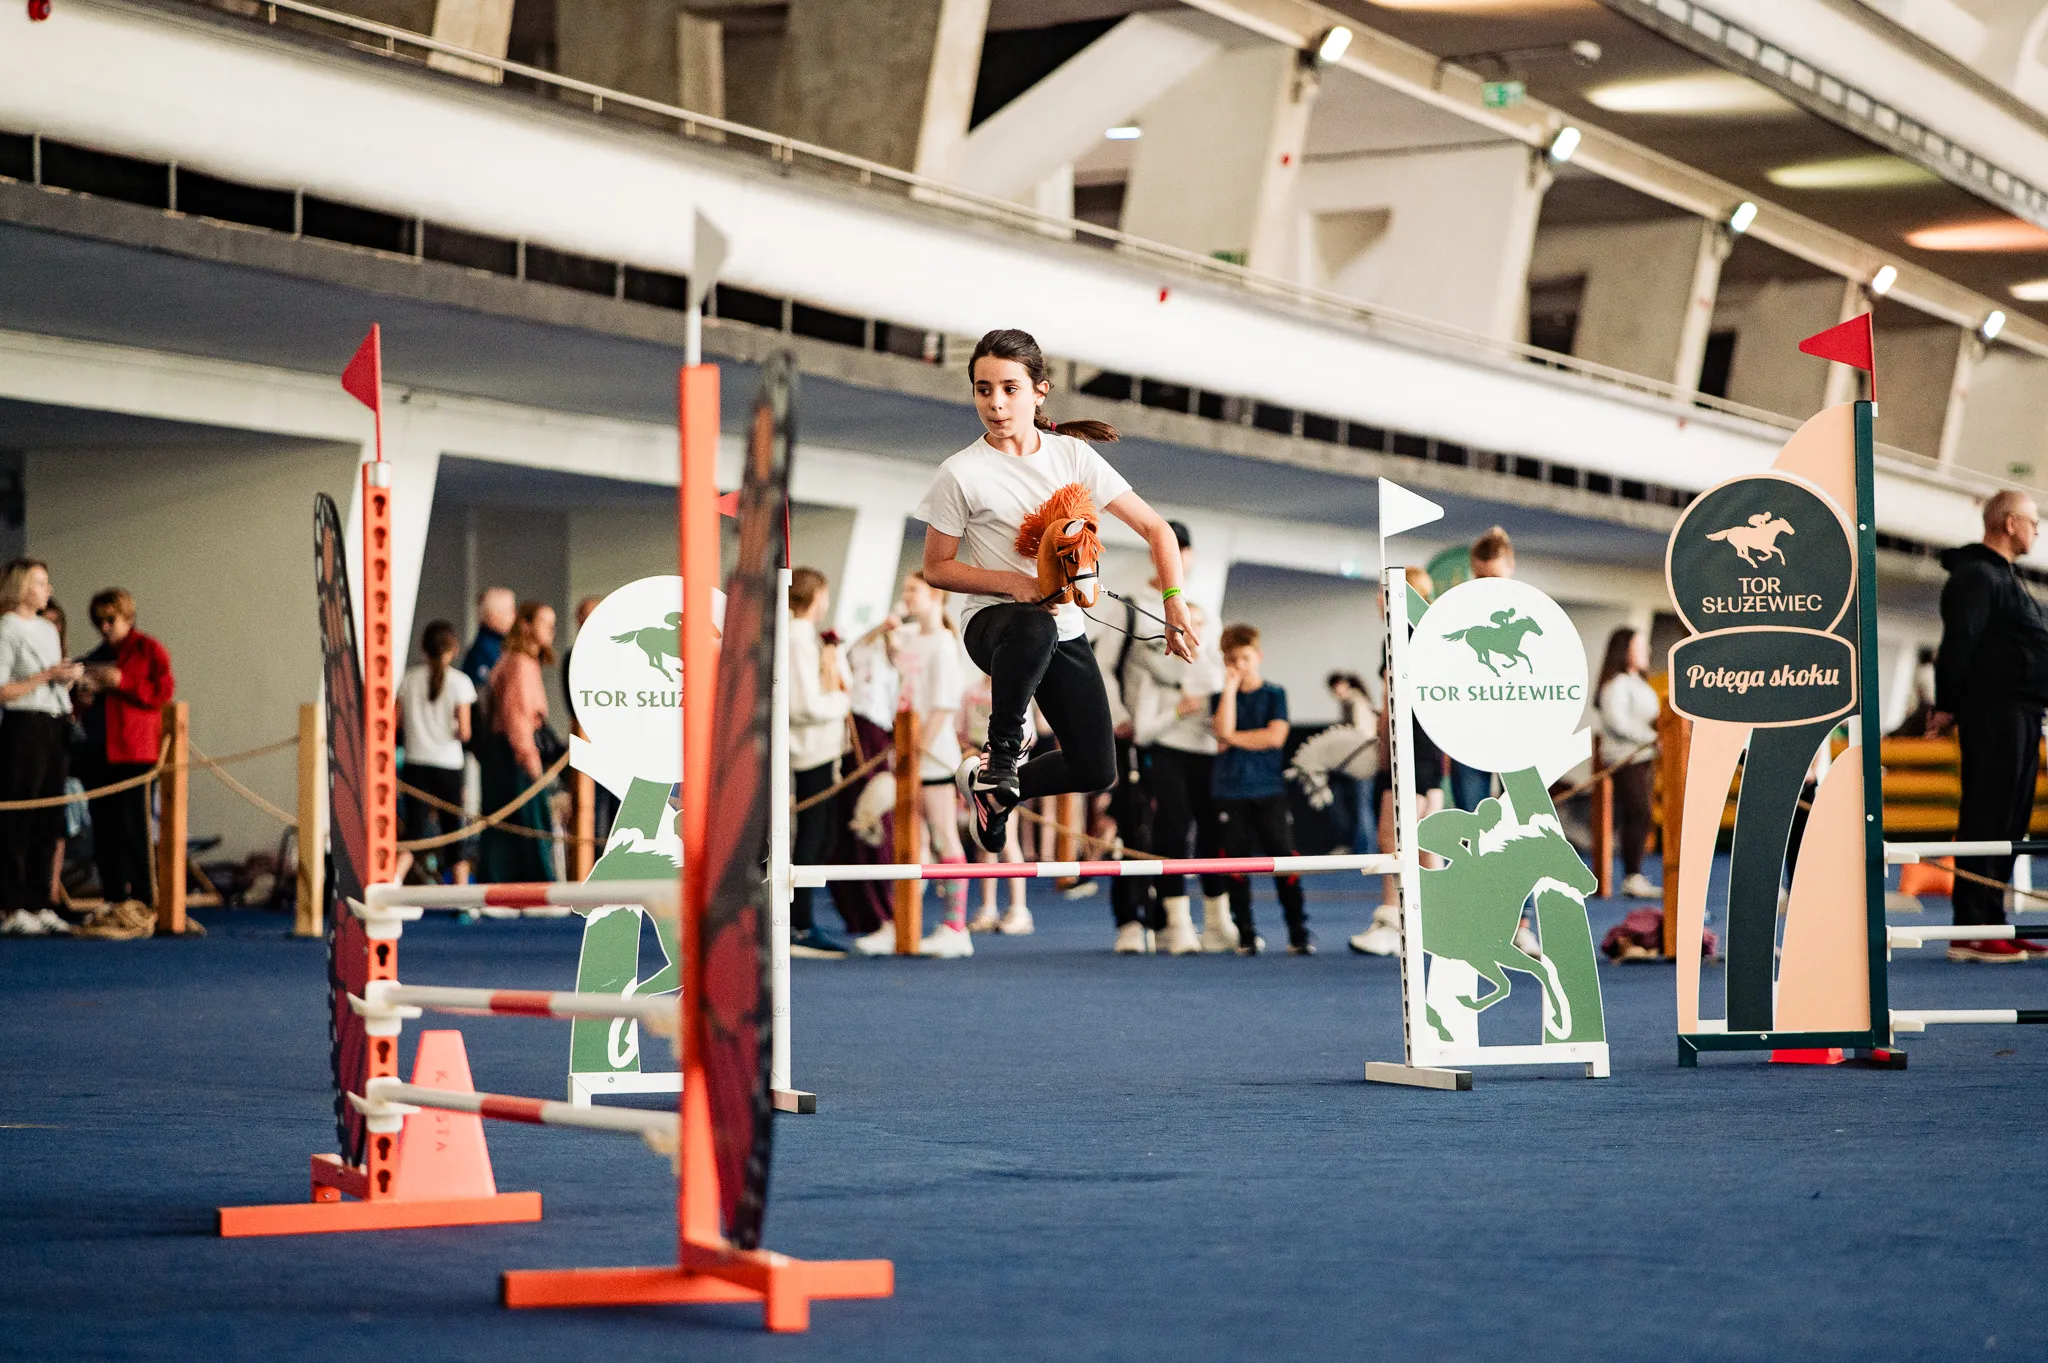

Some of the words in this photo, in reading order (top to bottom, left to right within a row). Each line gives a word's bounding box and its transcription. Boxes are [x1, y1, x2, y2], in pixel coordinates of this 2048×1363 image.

[1738, 576, 1782, 594] TOR
[1686, 664, 1766, 695] Potęga
[1769, 663, 1840, 687] skoku
[579, 690, 629, 708] TOR
[1416, 686, 1461, 702] TOR
[1467, 681, 1581, 701] SŁUŻEWIEC
